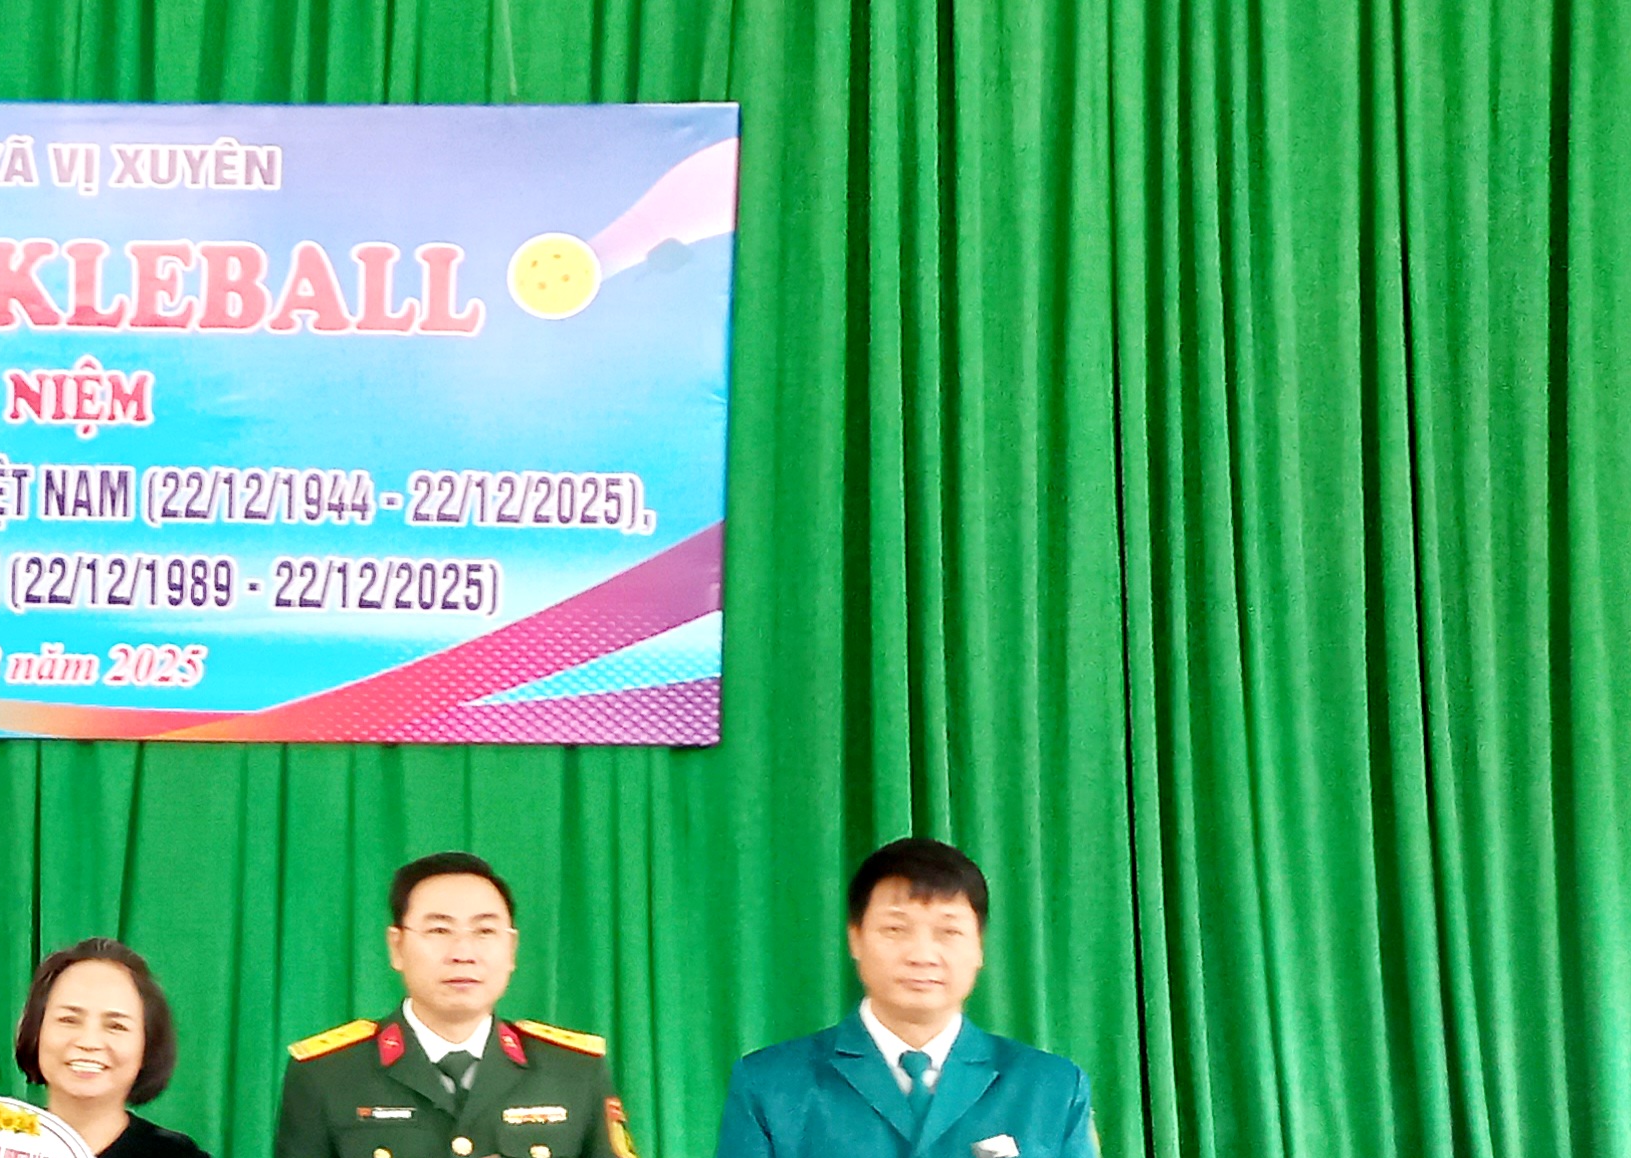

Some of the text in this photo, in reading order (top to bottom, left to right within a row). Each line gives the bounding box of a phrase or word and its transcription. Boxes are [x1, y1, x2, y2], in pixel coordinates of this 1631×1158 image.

[52, 144, 98, 191] VỊ
[115, 142, 278, 186] XUYÊN
[9, 359, 150, 435] NIỆM
[43, 470, 130, 517] NAM
[147, 471, 371, 524] (22/12/1944
[412, 475, 654, 531] 22/12/2025),
[11, 555, 232, 609] (22/12/1989
[275, 560, 498, 615] 22/12/2025)
[8, 647, 97, 682] năm
[105, 648, 205, 684] 2025
